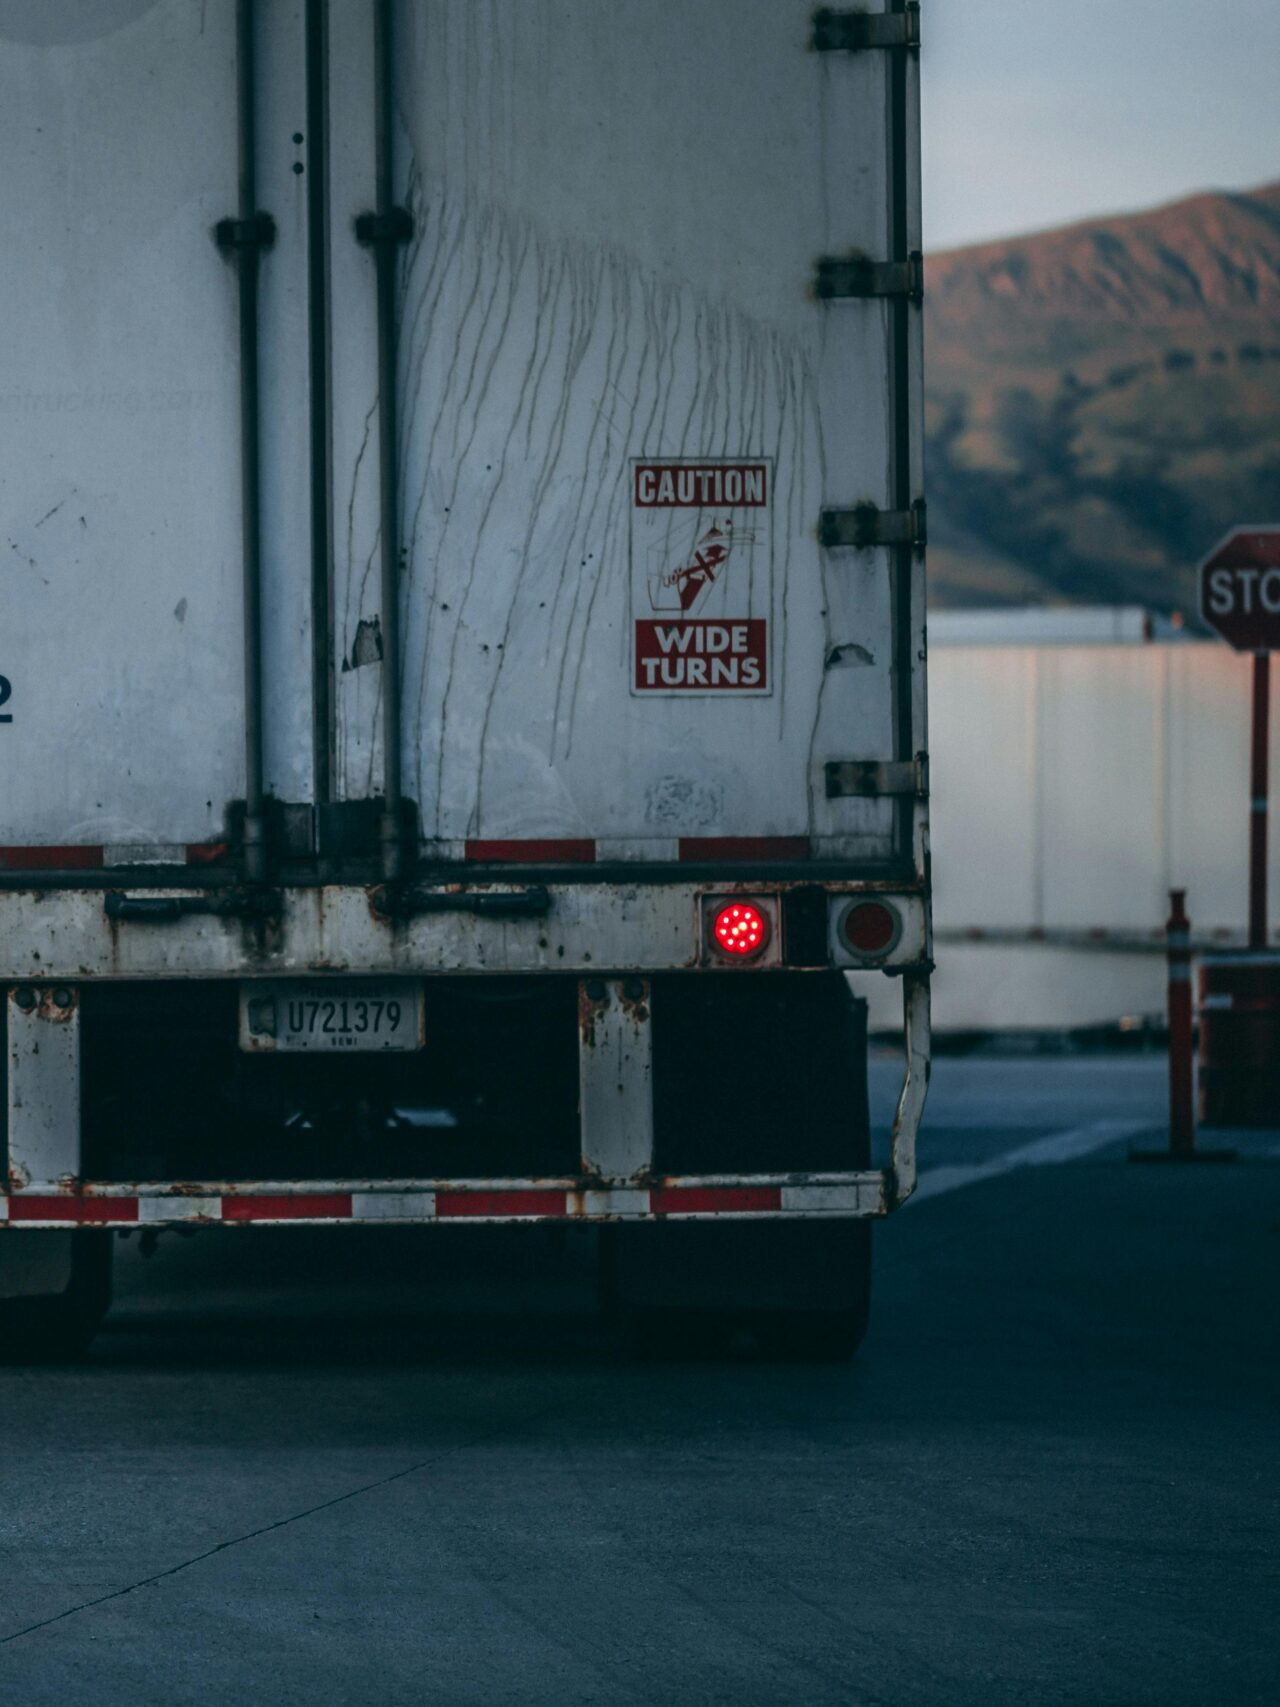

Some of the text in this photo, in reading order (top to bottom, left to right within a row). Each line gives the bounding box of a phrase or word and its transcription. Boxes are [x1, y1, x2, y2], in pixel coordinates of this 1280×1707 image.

[638, 470, 763, 503] CAUTION
[655, 626, 748, 653] WIDE
[641, 657, 760, 685] TURNS
[288, 1001, 402, 1033] U721379
